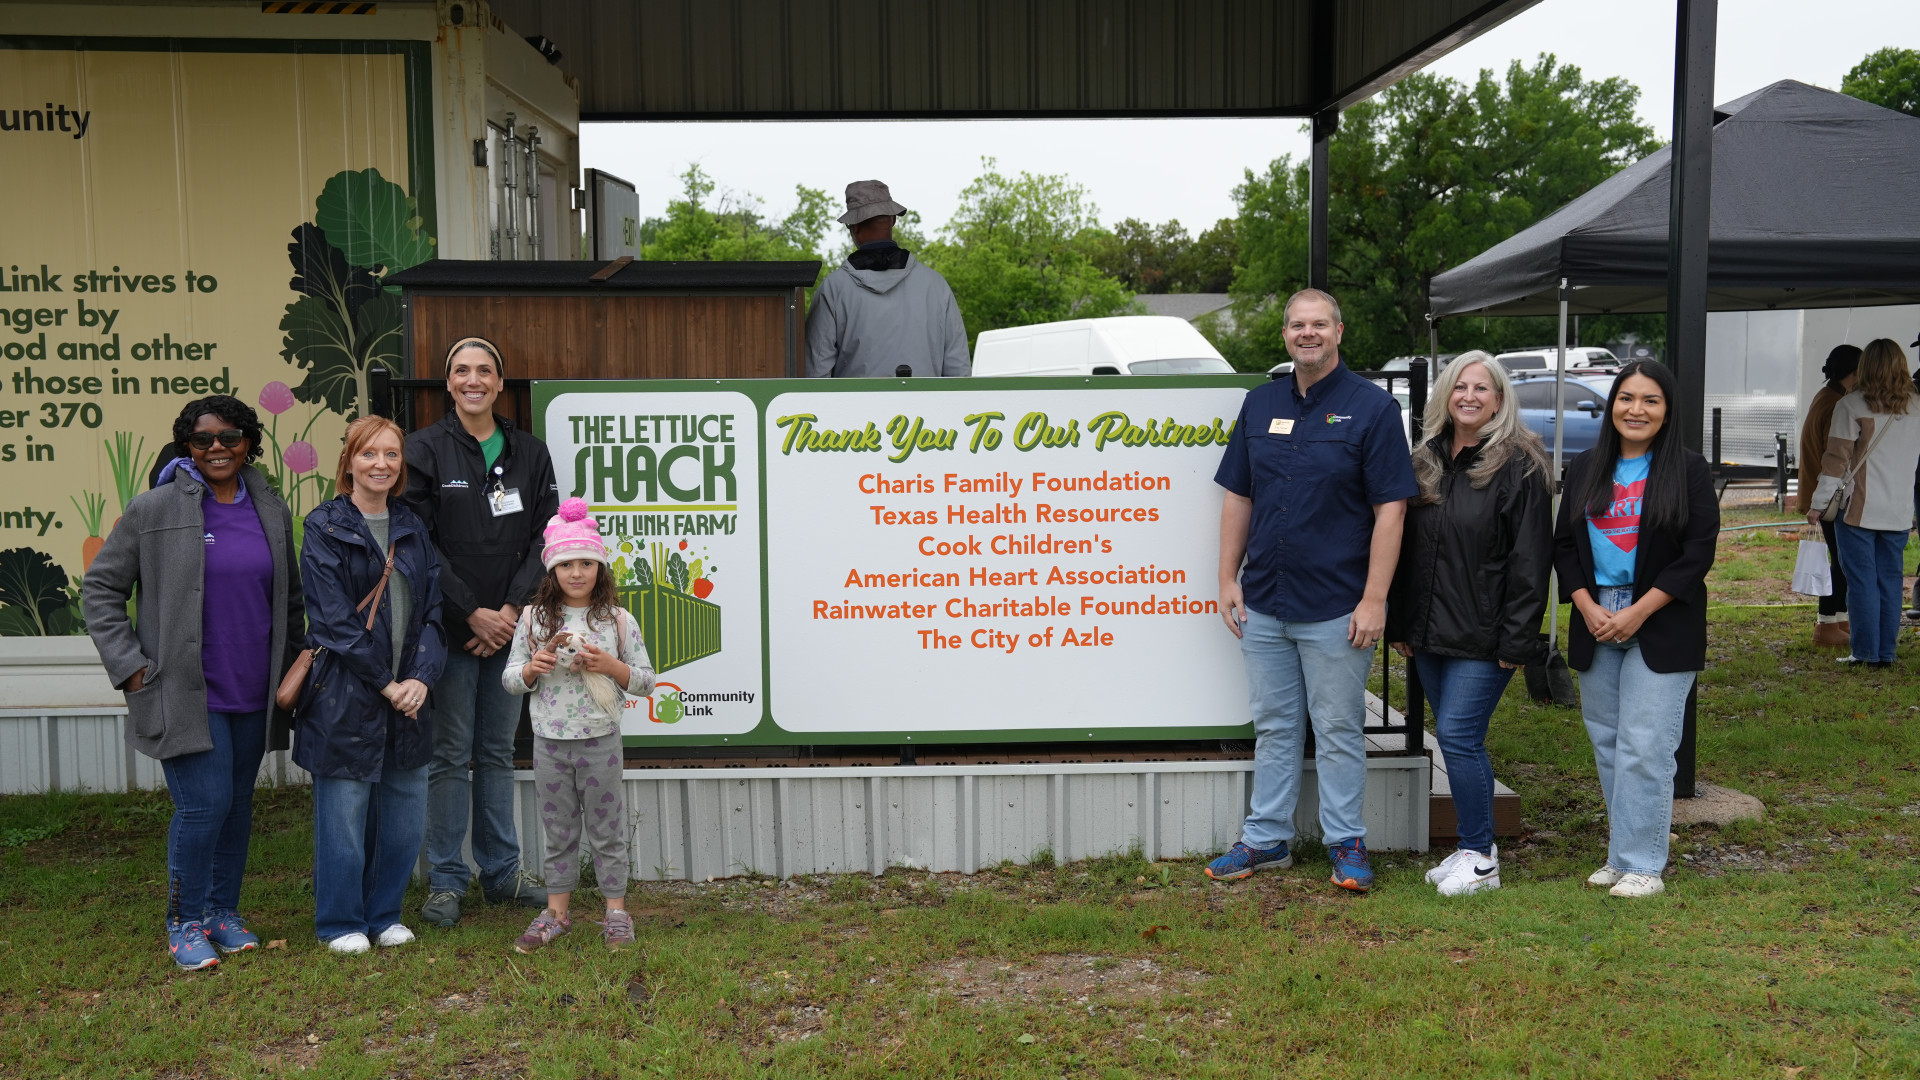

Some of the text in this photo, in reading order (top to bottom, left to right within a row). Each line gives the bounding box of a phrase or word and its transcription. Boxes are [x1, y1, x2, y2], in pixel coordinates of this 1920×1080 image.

[0, 264, 218, 293] Link strives to
[77, 299, 119, 334] by
[0, 333, 217, 361] od and other
[12, 367, 102, 394] those
[112, 368, 140, 394] in
[151, 367, 239, 397] need,
[39, 403, 103, 428] 370
[568, 414, 735, 444] THE LETTUCE
[25, 435, 54, 462] in
[776, 413, 882, 456] Thank
[886, 414, 958, 463] You
[964, 411, 1006, 454] To
[1013, 411, 1080, 452] Our
[570, 445, 737, 502] SHACK
[858, 470, 1171, 498] Charis Family Foundation
[0, 507, 63, 536] nty.
[633, 514, 669, 536] LINK
[674, 514, 737, 536] FARMS
[870, 503, 1160, 525] Texas Health Resources
[919, 534, 1113, 556] Cook Children's
[844, 564, 1186, 588] American Heart Association
[813, 594, 1218, 620] Rainwater Charitable Foundation
[917, 626, 1114, 654] The City of Azle
[678, 690, 755, 703] Community
[684, 705, 713, 716] Link
